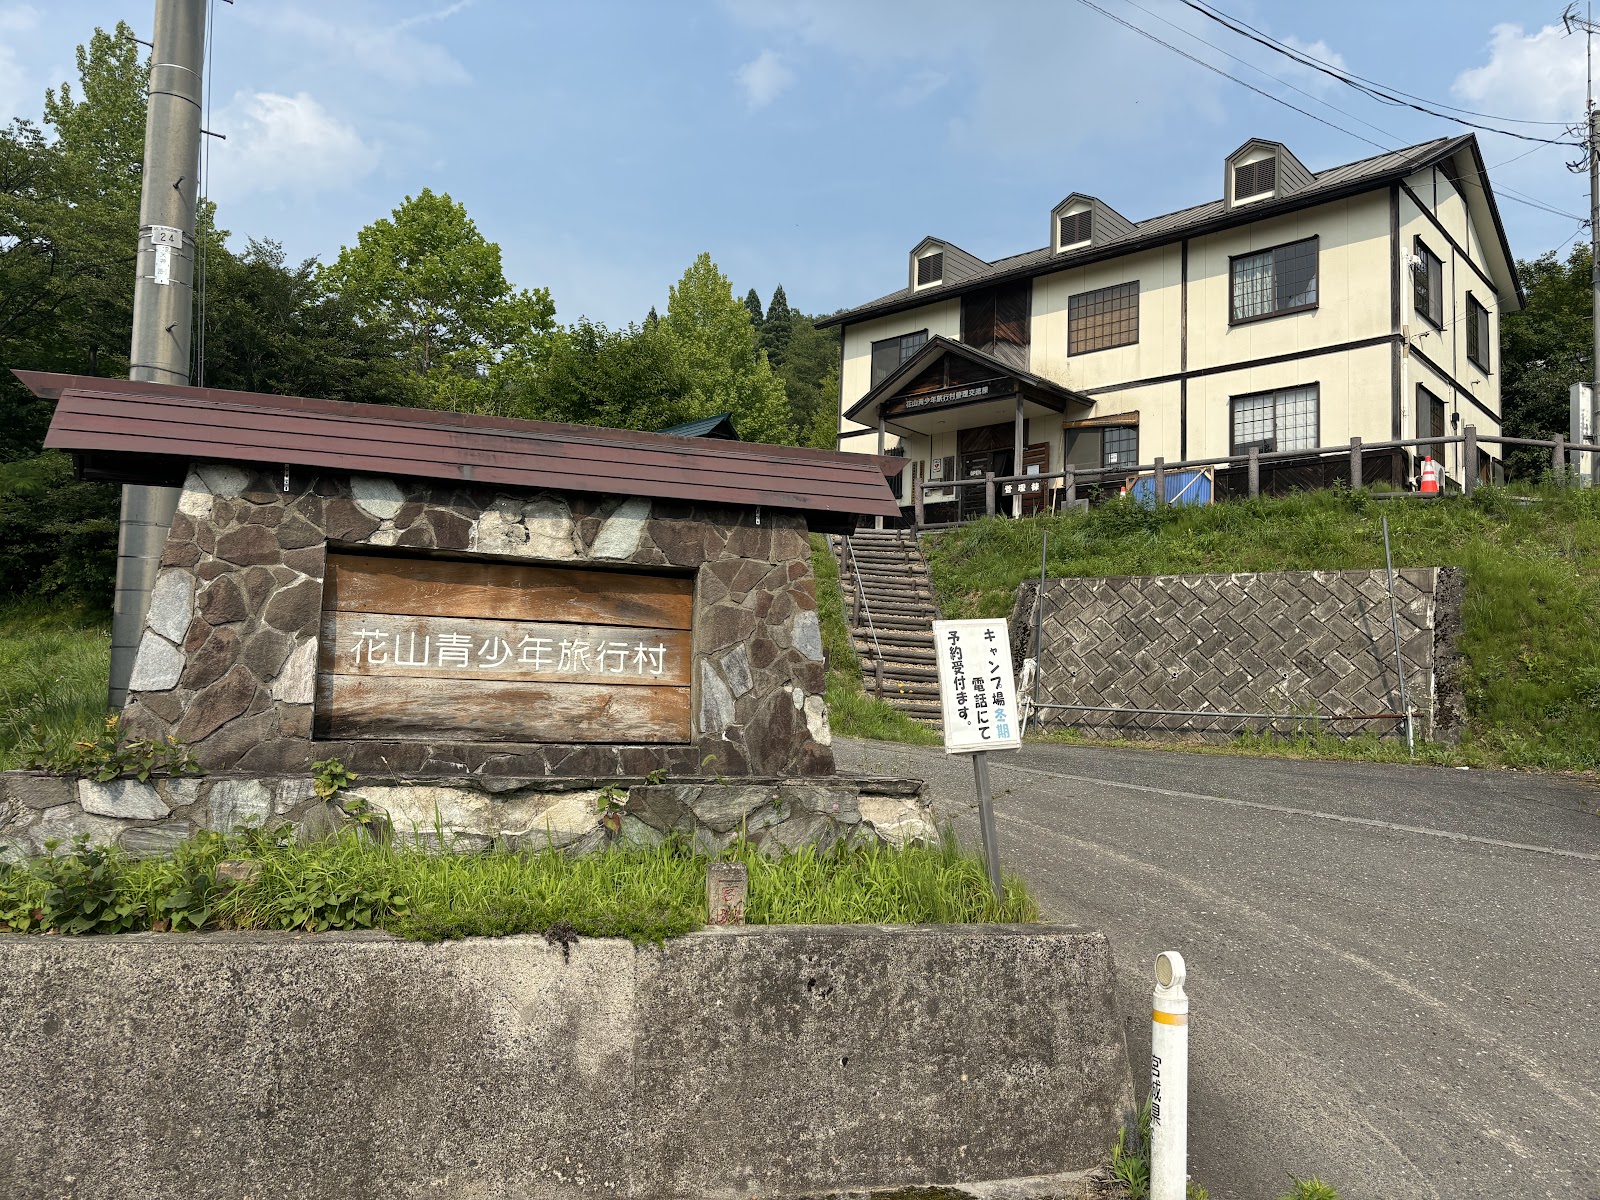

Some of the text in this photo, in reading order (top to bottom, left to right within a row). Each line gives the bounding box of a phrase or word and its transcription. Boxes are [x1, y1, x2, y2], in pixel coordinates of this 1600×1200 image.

[160, 232, 174, 242] 24
[350, 628, 667, 675] 花山青少年旅行村
[947, 630, 971, 726] 予約受付ます。
[972, 676, 991, 740] 電話にて
